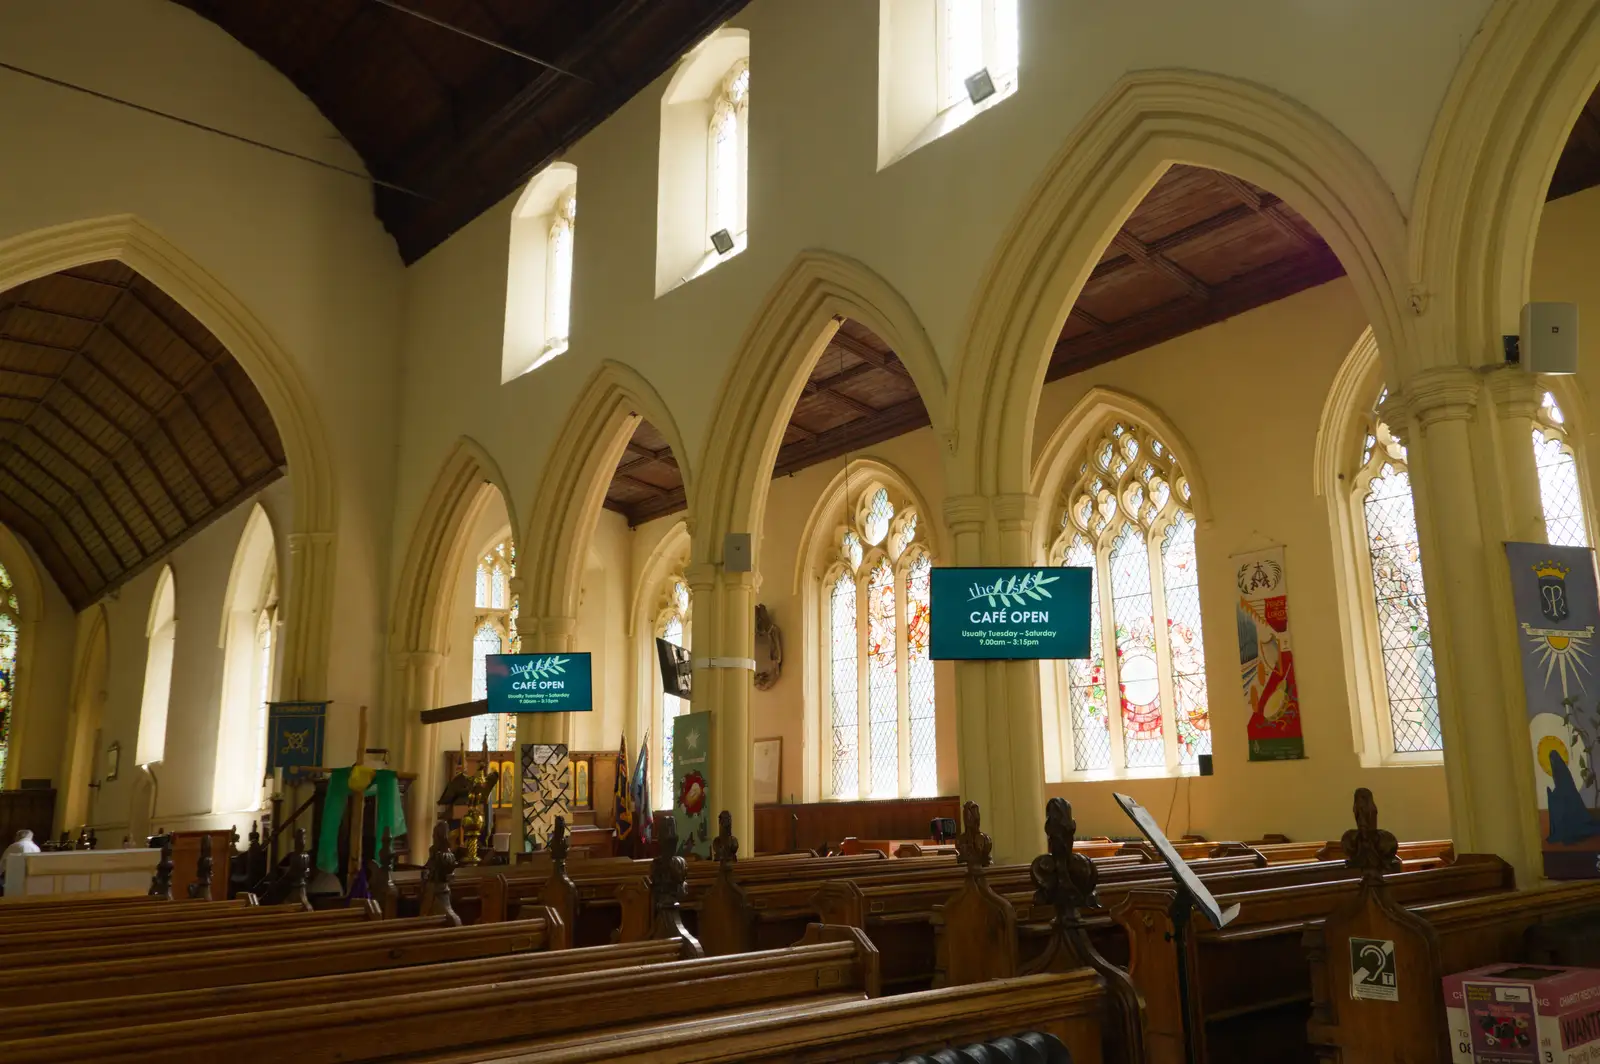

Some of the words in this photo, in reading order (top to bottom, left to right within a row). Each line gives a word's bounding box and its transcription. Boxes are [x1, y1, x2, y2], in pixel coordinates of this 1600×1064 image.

[968, 582, 995, 598] the
[969, 608, 1007, 624] CAFÉ
[1011, 611, 1049, 623] OPEN
[961, 630, 987, 638] Usually
[988, 630, 1018, 638] Tuesday
[1024, 630, 1057, 638] Saturday
[1013, 638, 1039, 647] 3:15pm
[512, 679, 537, 690] CAFÉ
[539, 681, 565, 689] OPEN
[1383, 973, 1393, 985] T
